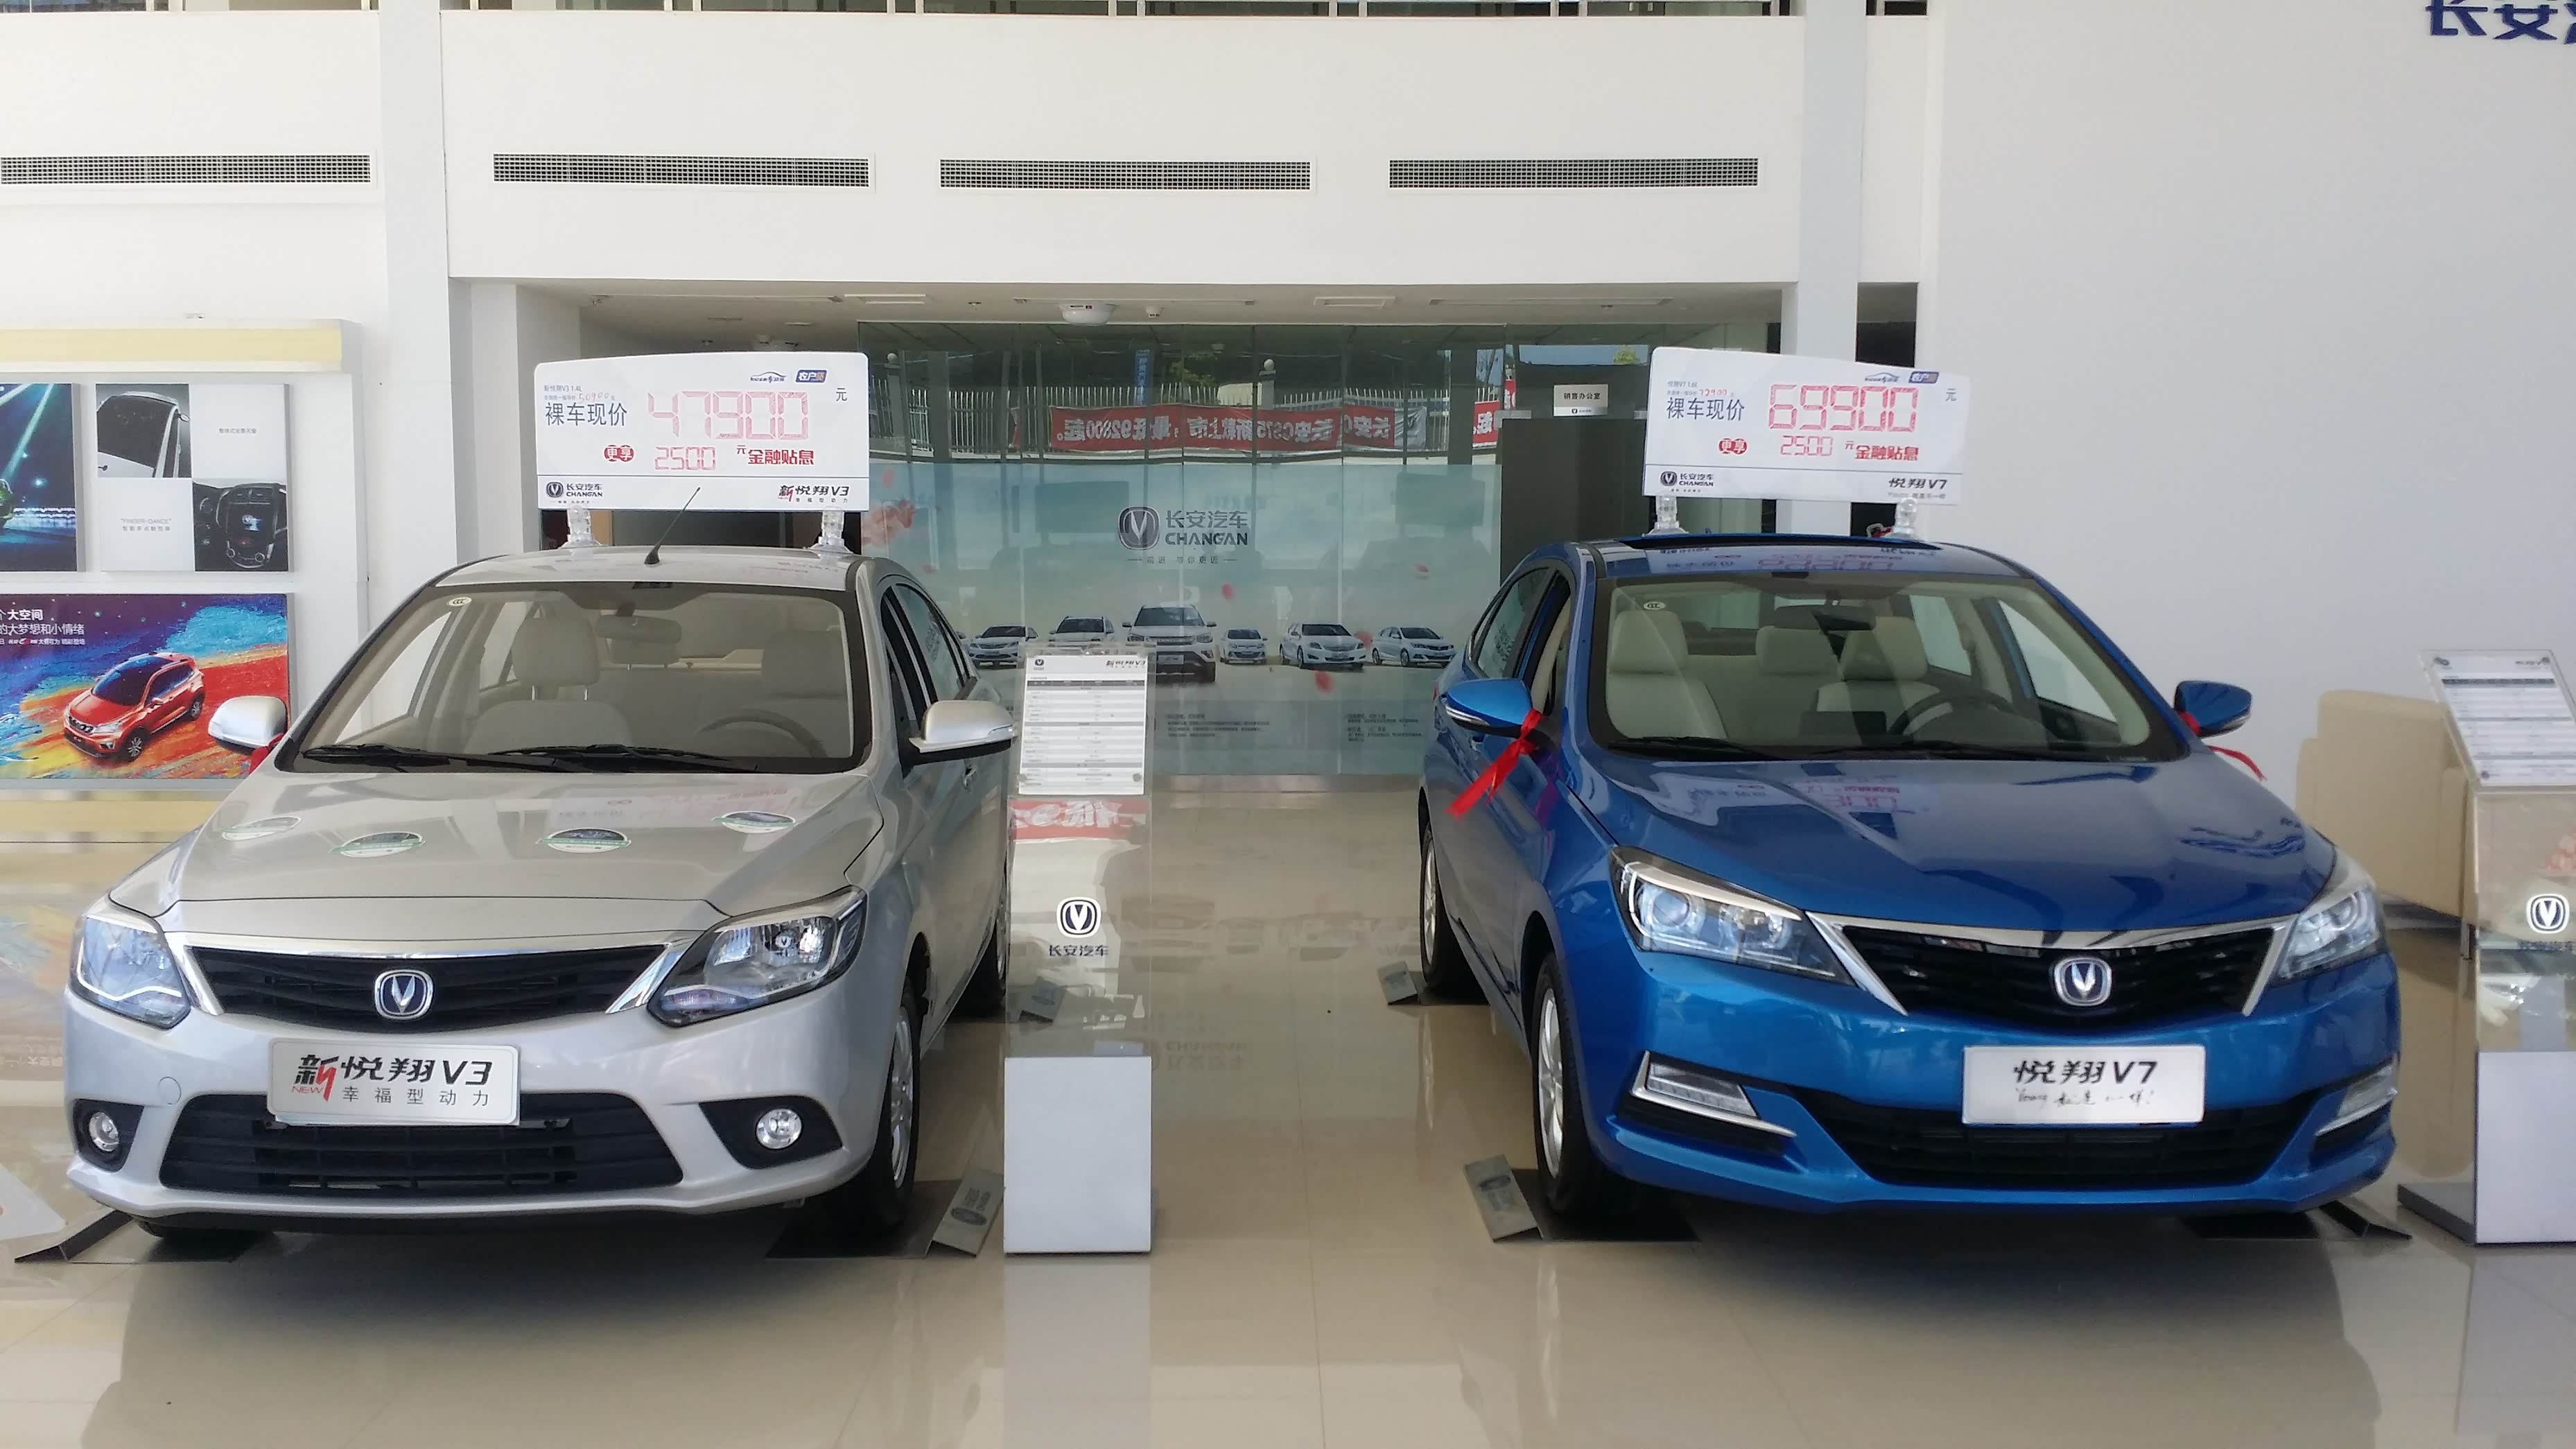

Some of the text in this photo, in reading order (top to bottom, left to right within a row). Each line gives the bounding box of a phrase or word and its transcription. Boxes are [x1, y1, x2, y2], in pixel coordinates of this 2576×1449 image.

[2426, 0, 2576, 44] 长安
[579, 392, 609, 402] 50900
[1666, 384, 1957, 433] 裸车现价 69900 元
[545, 388, 847, 440] 裸车现价 47900 元
[605, 445, 815, 471] 更享 2500 元 金融贴息
[1780, 435, 1833, 456] 2500
[1845, 441, 1854, 450] 元
[1855, 445, 1920, 461] 金融贴息
[778, 485, 849, 502] 新悦翔V3
[1888, 478, 1947, 489] 悦翔V7
[1166, 510, 1248, 528] 长安汽车
[1165, 532, 1248, 546] CHANGAN
[1049, 945, 1109, 957] 长安汽车
[294, 1054, 493, 1102] 新悦翔V3
[2012, 1060, 2158, 1085] 悦翔V7
[342, 1086, 489, 1107] 幸福型动力
